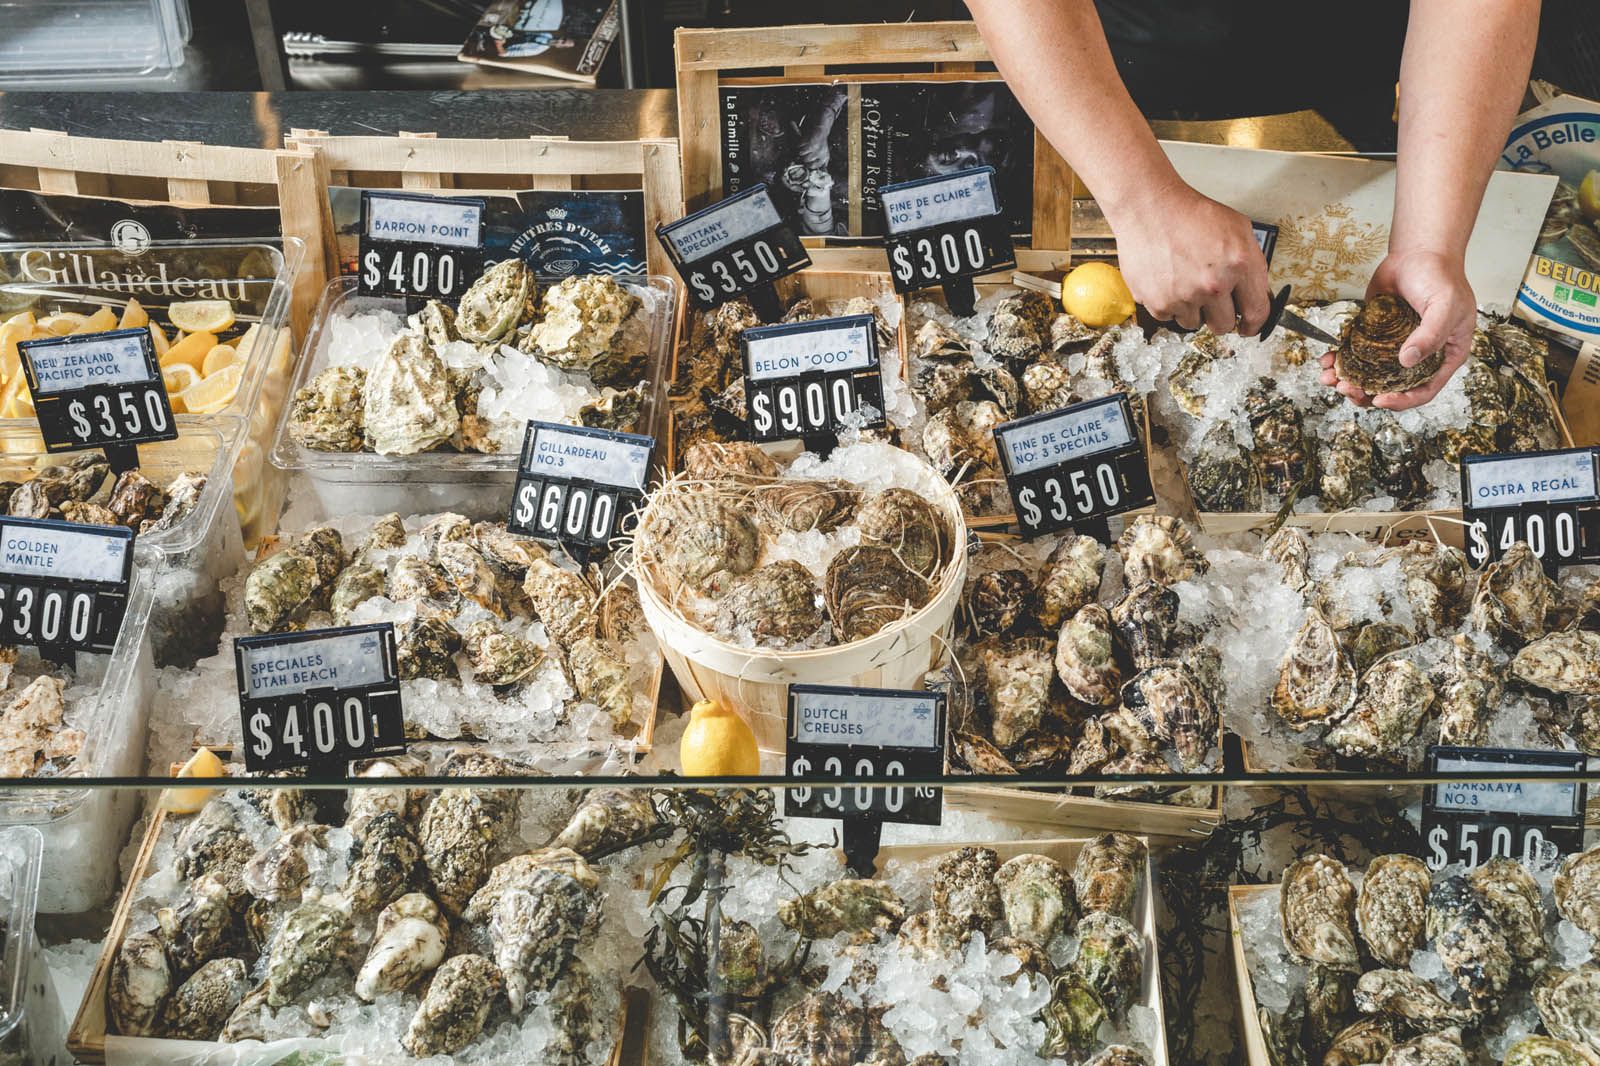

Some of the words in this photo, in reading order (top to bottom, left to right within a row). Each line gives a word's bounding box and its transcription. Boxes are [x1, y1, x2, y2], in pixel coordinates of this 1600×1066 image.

[726, 95, 738, 110] La
[727, 114, 740, 159] Famille
[1501, 144, 1534, 168] La
[1531, 123, 1596, 150] Belle
[730, 177, 741, 196] Bo
[863, 164, 881, 211] Regal
[889, 200, 912, 213] FINE
[916, 197, 930, 208] DE
[933, 188, 972, 204] CLAIRE
[374, 219, 426, 236] BARRON
[431, 224, 471, 239] POINT
[891, 214, 912, 225] NO.
[915, 210, 923, 220] 3
[565, 221, 613, 256] D'UTAH
[676, 220, 724, 248] BRITTANY
[682, 229, 730, 256] SPECIALS
[893, 228, 985, 285] $3.00
[19, 249, 251, 302] Gillardeau
[364, 248, 454, 295] $4.00
[690, 240, 780, 303] $3.50
[34, 358, 58, 370] NEW
[63, 352, 115, 367] ZEALAND
[37, 368, 84, 382] PACIFIC
[87, 363, 121, 377] ROCK
[755, 357, 800, 373] BELON
[68, 389, 168, 442] $3.50
[752, 378, 852, 436] $9.00
[1012, 437, 1038, 453] FINE
[1042, 432, 1057, 445] DE
[1060, 419, 1103, 440] CLAIRE
[1015, 452, 1038, 465] NO.
[1042, 448, 1050, 459] 3
[1054, 431, 1110, 456] SPECIALS
[539, 440, 608, 461] GILLARDEAU
[1018, 463, 1120, 530] $3.50
[1478, 482, 1526, 498] OSTRA
[1531, 476, 1580, 493] REGAL
[516, 482, 612, 539] $6.00
[5, 553, 54, 568] MANTLE
[7, 539, 59, 555] GOLDEN
[250, 654, 324, 675] SPECIALES
[252, 673, 288, 690] UTAH
[293, 667, 338, 684] BEACH
[803, 707, 848, 720] DUTCH
[249, 696, 366, 760] $4.00
[803, 722, 864, 735] CREUSES
[791, 754, 905, 814] $3.00
[914, 785, 935, 799] KG
